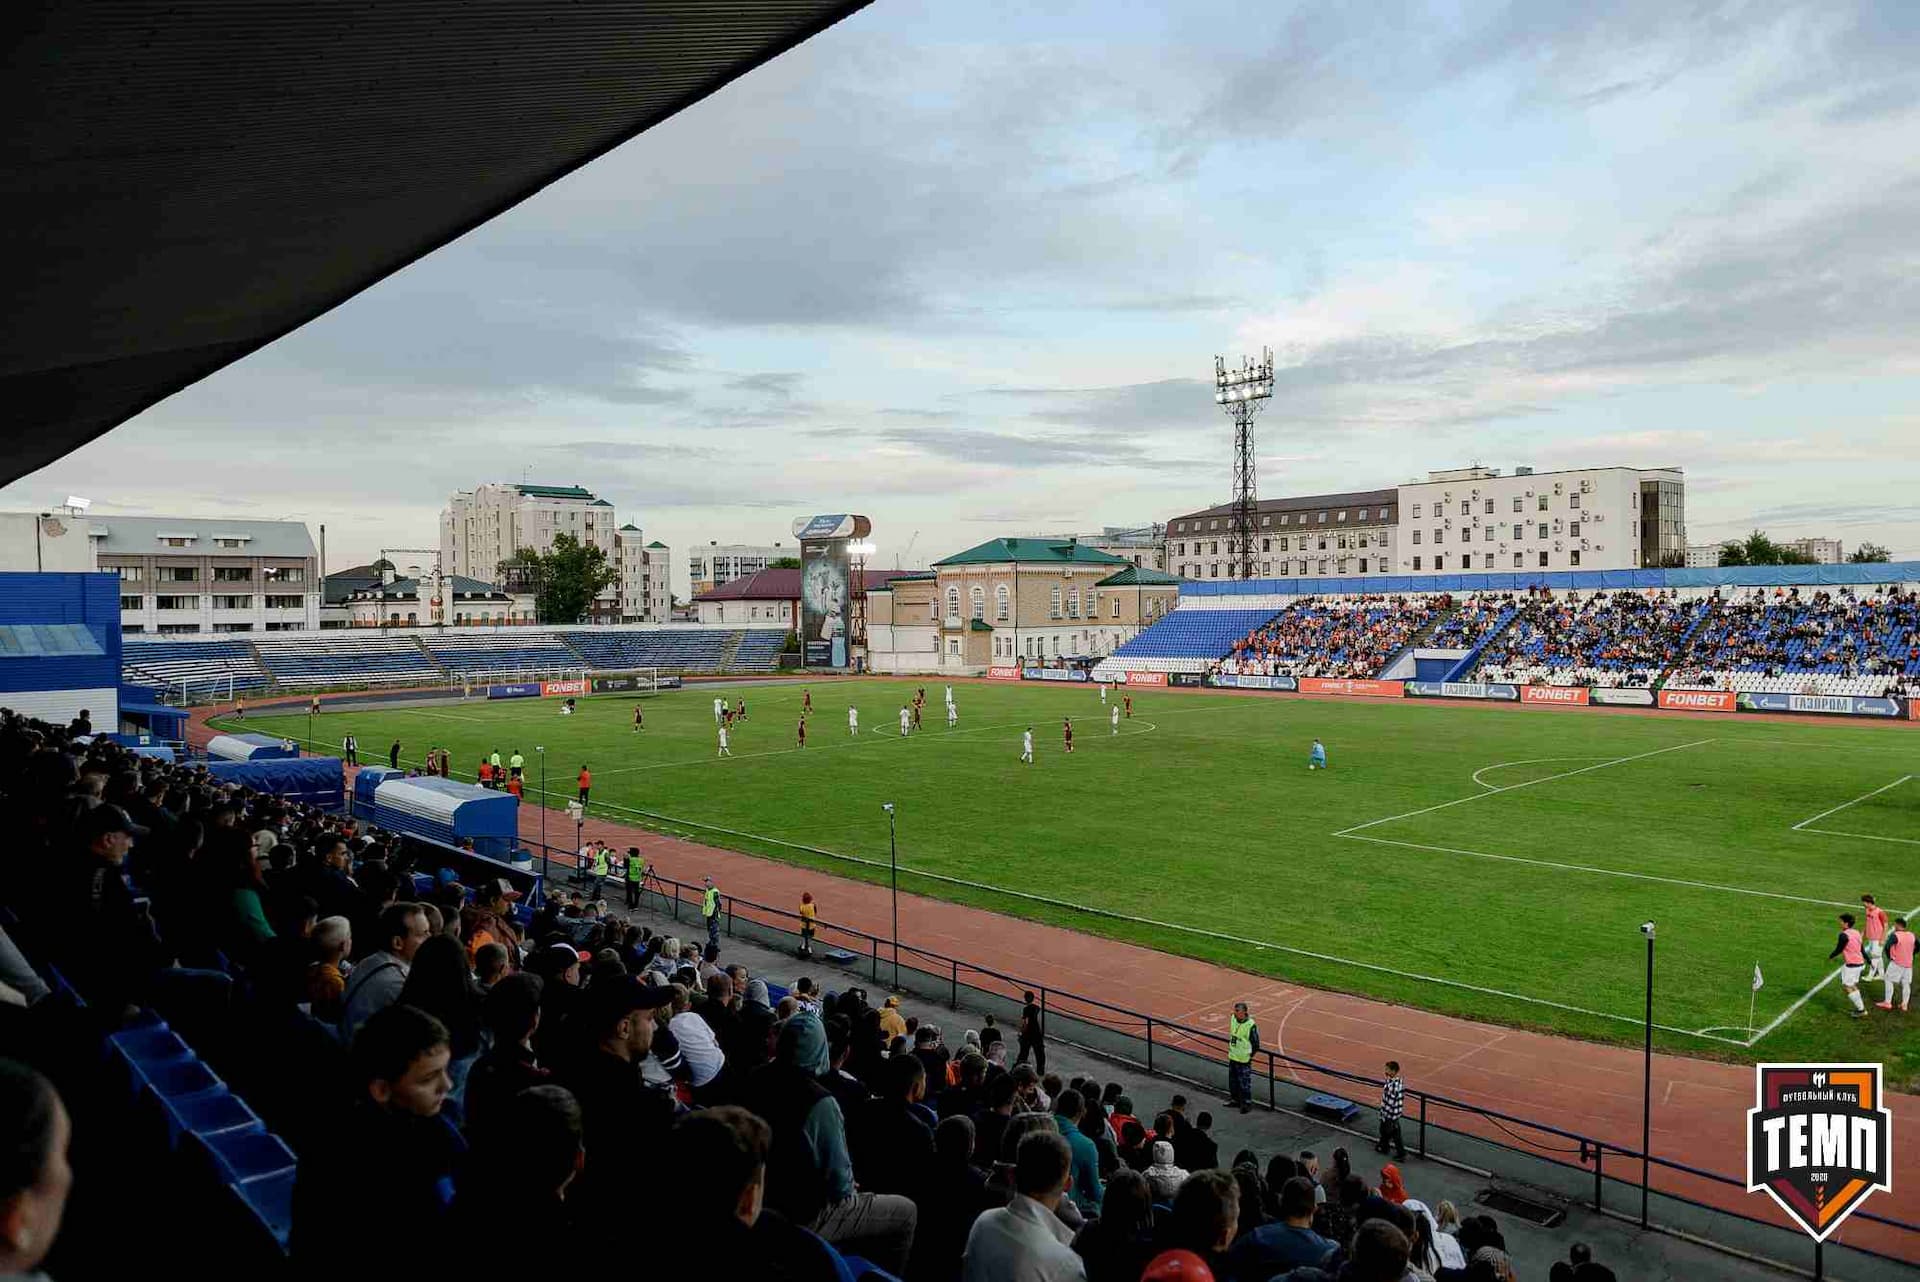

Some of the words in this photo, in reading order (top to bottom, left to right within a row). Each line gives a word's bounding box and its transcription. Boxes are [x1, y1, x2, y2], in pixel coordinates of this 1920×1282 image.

[1130, 673, 1164, 684] FONBET
[1528, 688, 1582, 700] FONBET
[1665, 693, 1729, 706] FONBET
[1794, 697, 1848, 711] ГАЗПРОМ
